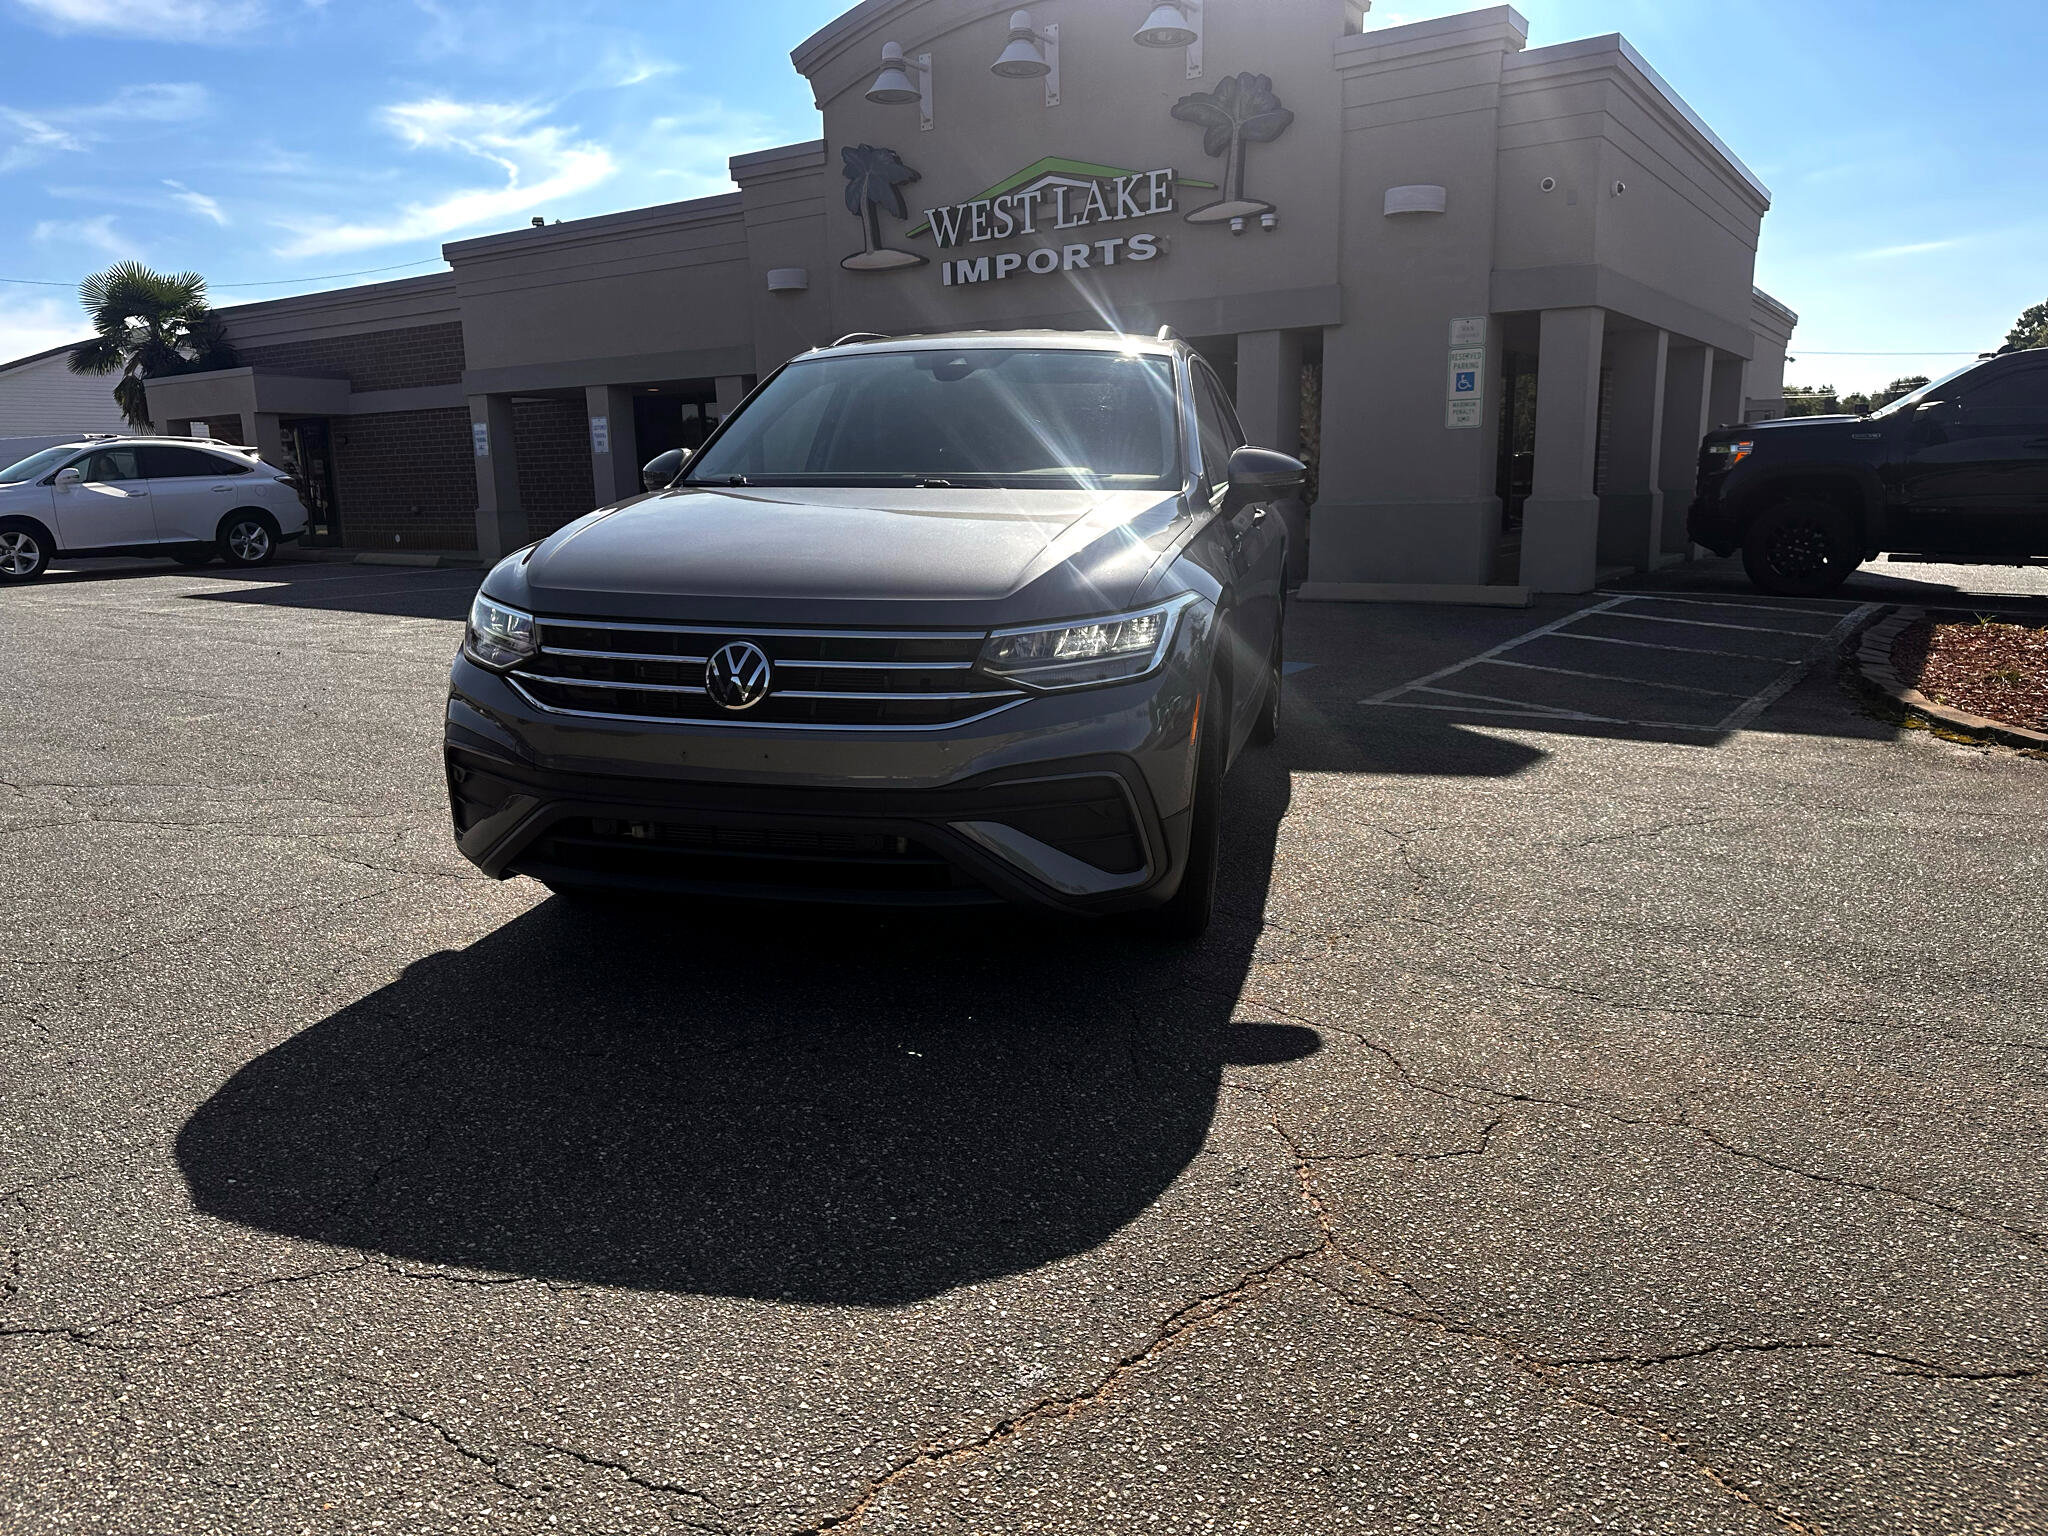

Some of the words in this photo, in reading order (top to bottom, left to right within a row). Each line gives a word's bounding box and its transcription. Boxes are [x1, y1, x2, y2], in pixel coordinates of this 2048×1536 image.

[923, 190, 1041, 249] WEST
[1053, 167, 1173, 231] LAKE
[942, 233, 1158, 286] IMPORTS
[1453, 361, 1480, 369] PARKING
